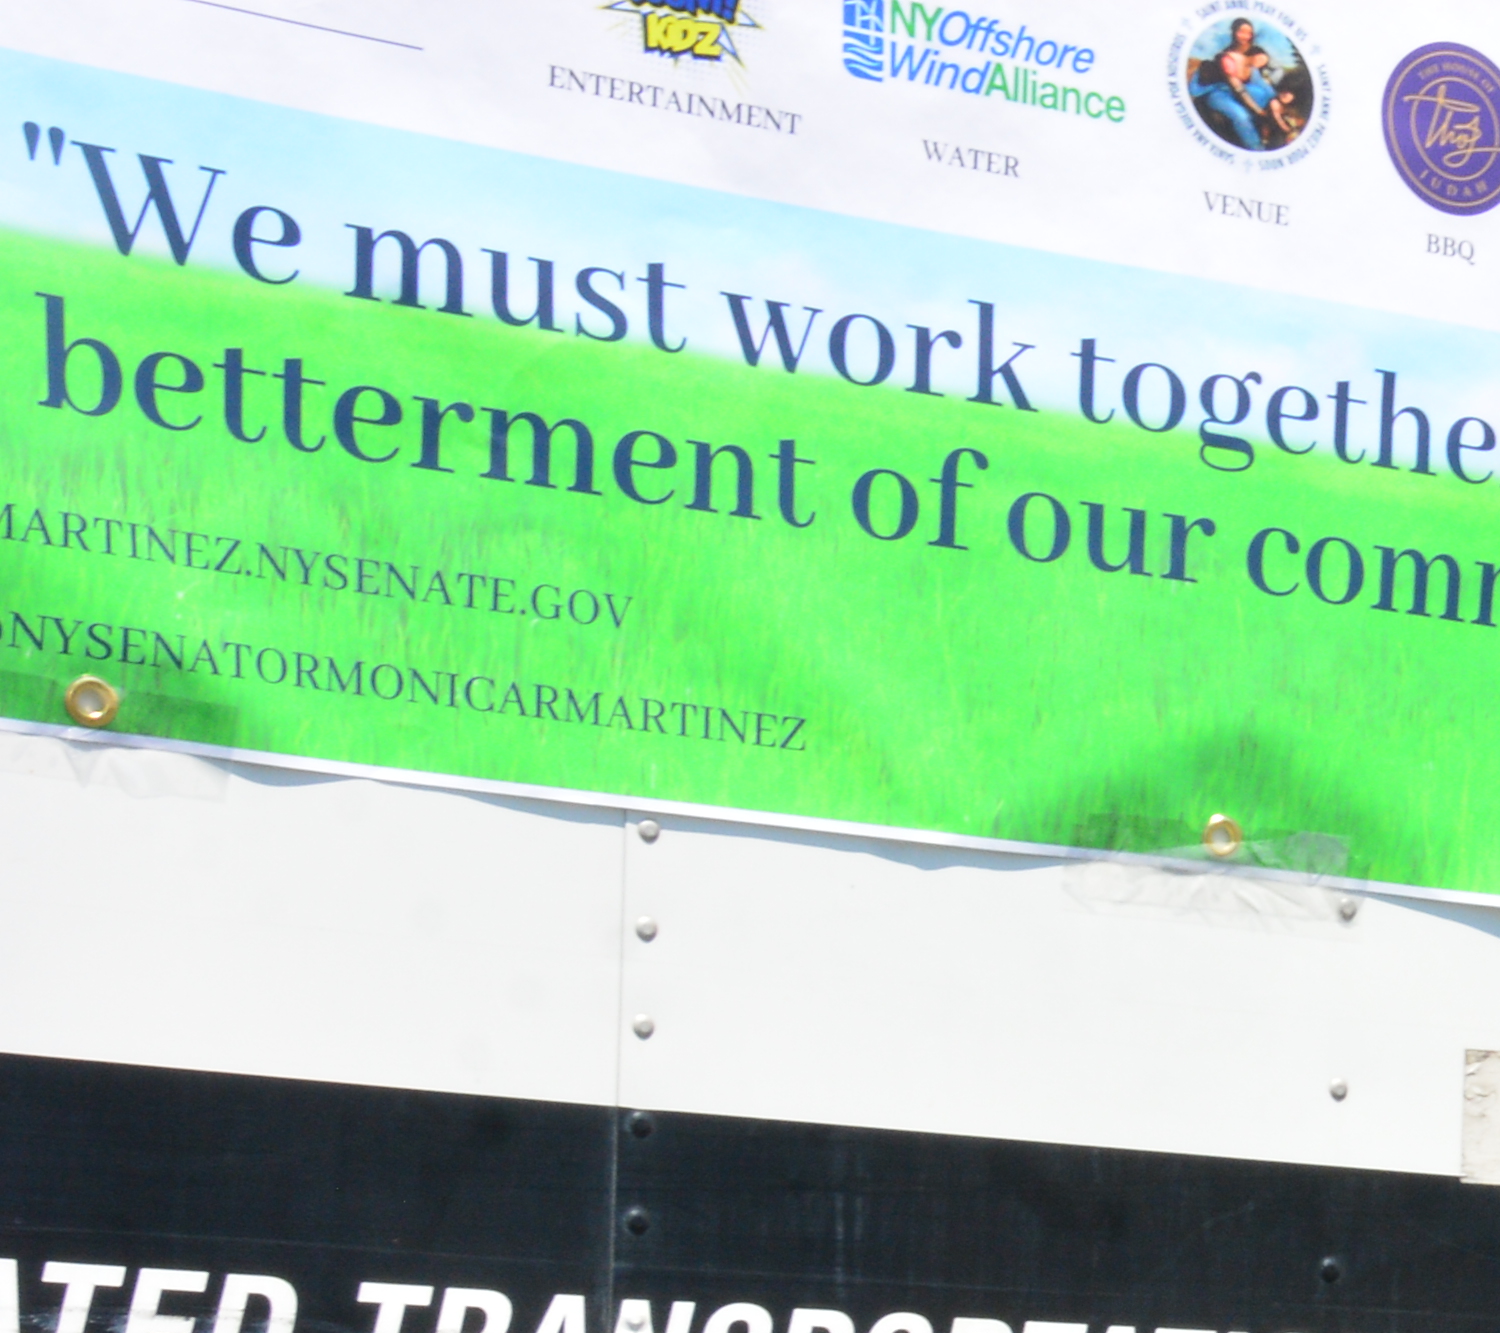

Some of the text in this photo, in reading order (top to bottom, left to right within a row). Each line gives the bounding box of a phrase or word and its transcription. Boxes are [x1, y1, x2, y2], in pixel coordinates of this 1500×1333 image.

[890, 0, 1095, 74] NYOffshore
[548, 63, 802, 136] ENTERTAINMENT
[890, 41, 1126, 123] WindAlliance
[921, 139, 1020, 178] WATER
[1202, 190, 1291, 228] VENUE
[21, 120, 303, 286] "We
[343, 218, 687, 354] must
[719, 296, 1040, 413] work
[1426, 232, 1477, 266] BBQ
[34, 291, 816, 531] betterment
[850, 447, 988, 551] of
[1007, 490, 1216, 586] our
[0, 608, 808, 755] NYSENATORMONICARMARTINEZ
